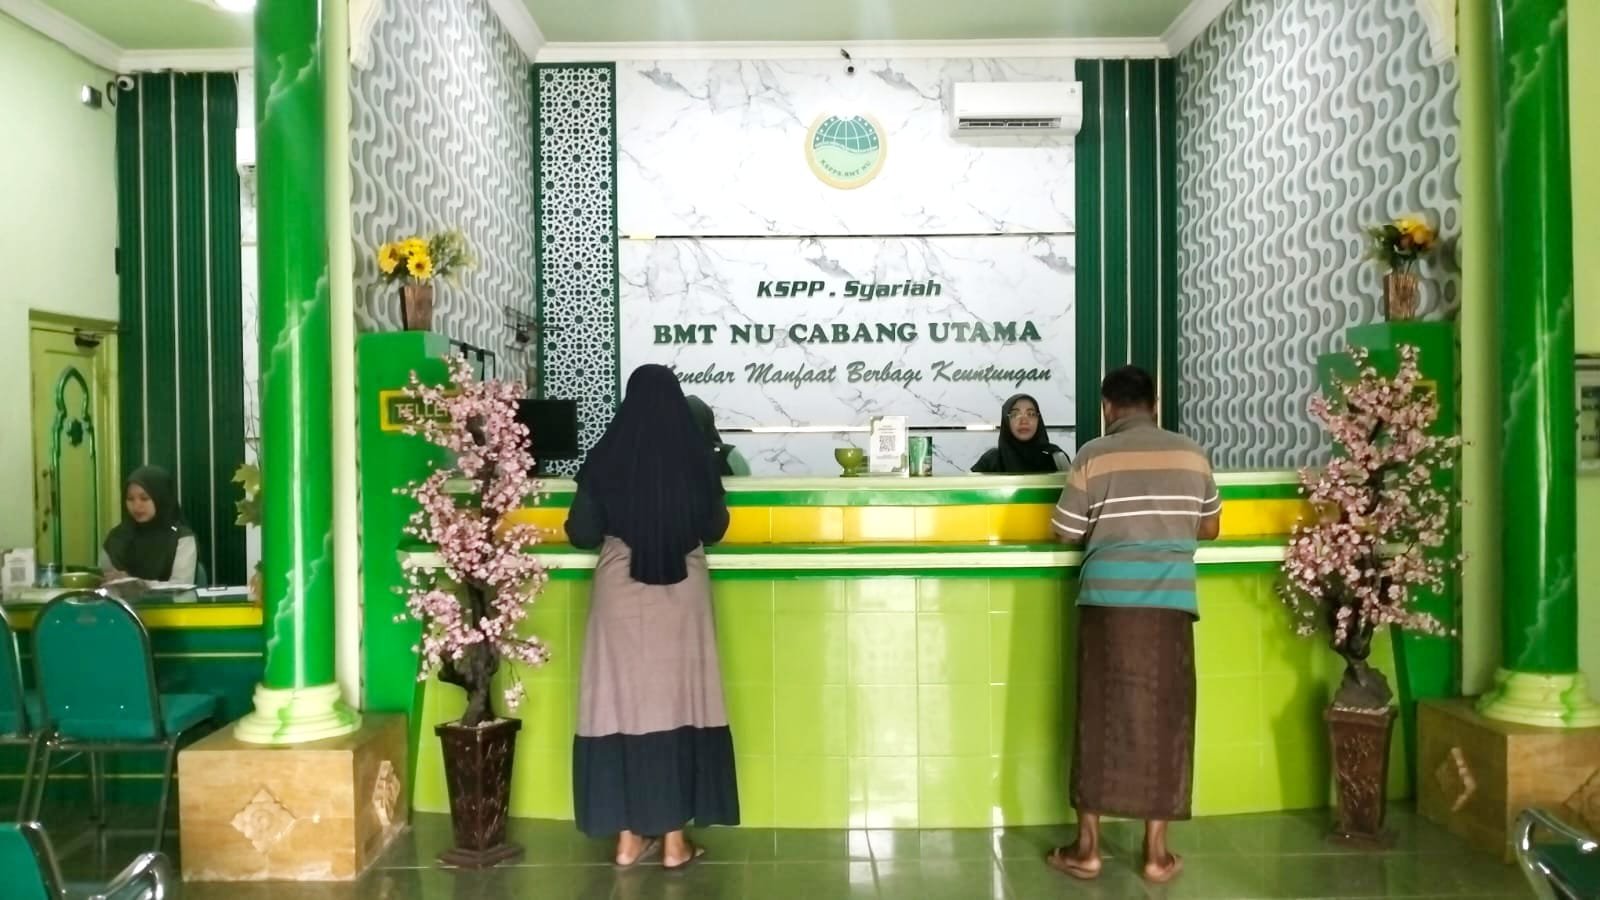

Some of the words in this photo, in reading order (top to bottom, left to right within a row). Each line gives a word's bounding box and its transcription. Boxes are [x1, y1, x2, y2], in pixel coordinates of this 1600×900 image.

[757, 280, 825, 298] KSPP
[843, 279, 942, 302] Syariah
[653, 324, 717, 345] BMT
[730, 323, 776, 344] NU
[788, 322, 918, 345] CABANG
[928, 320, 1042, 344] UTAMA
[664, 362, 736, 385] enebar
[744, 361, 837, 389] Manfaat
[930, 360, 1052, 389] Keuntungan
